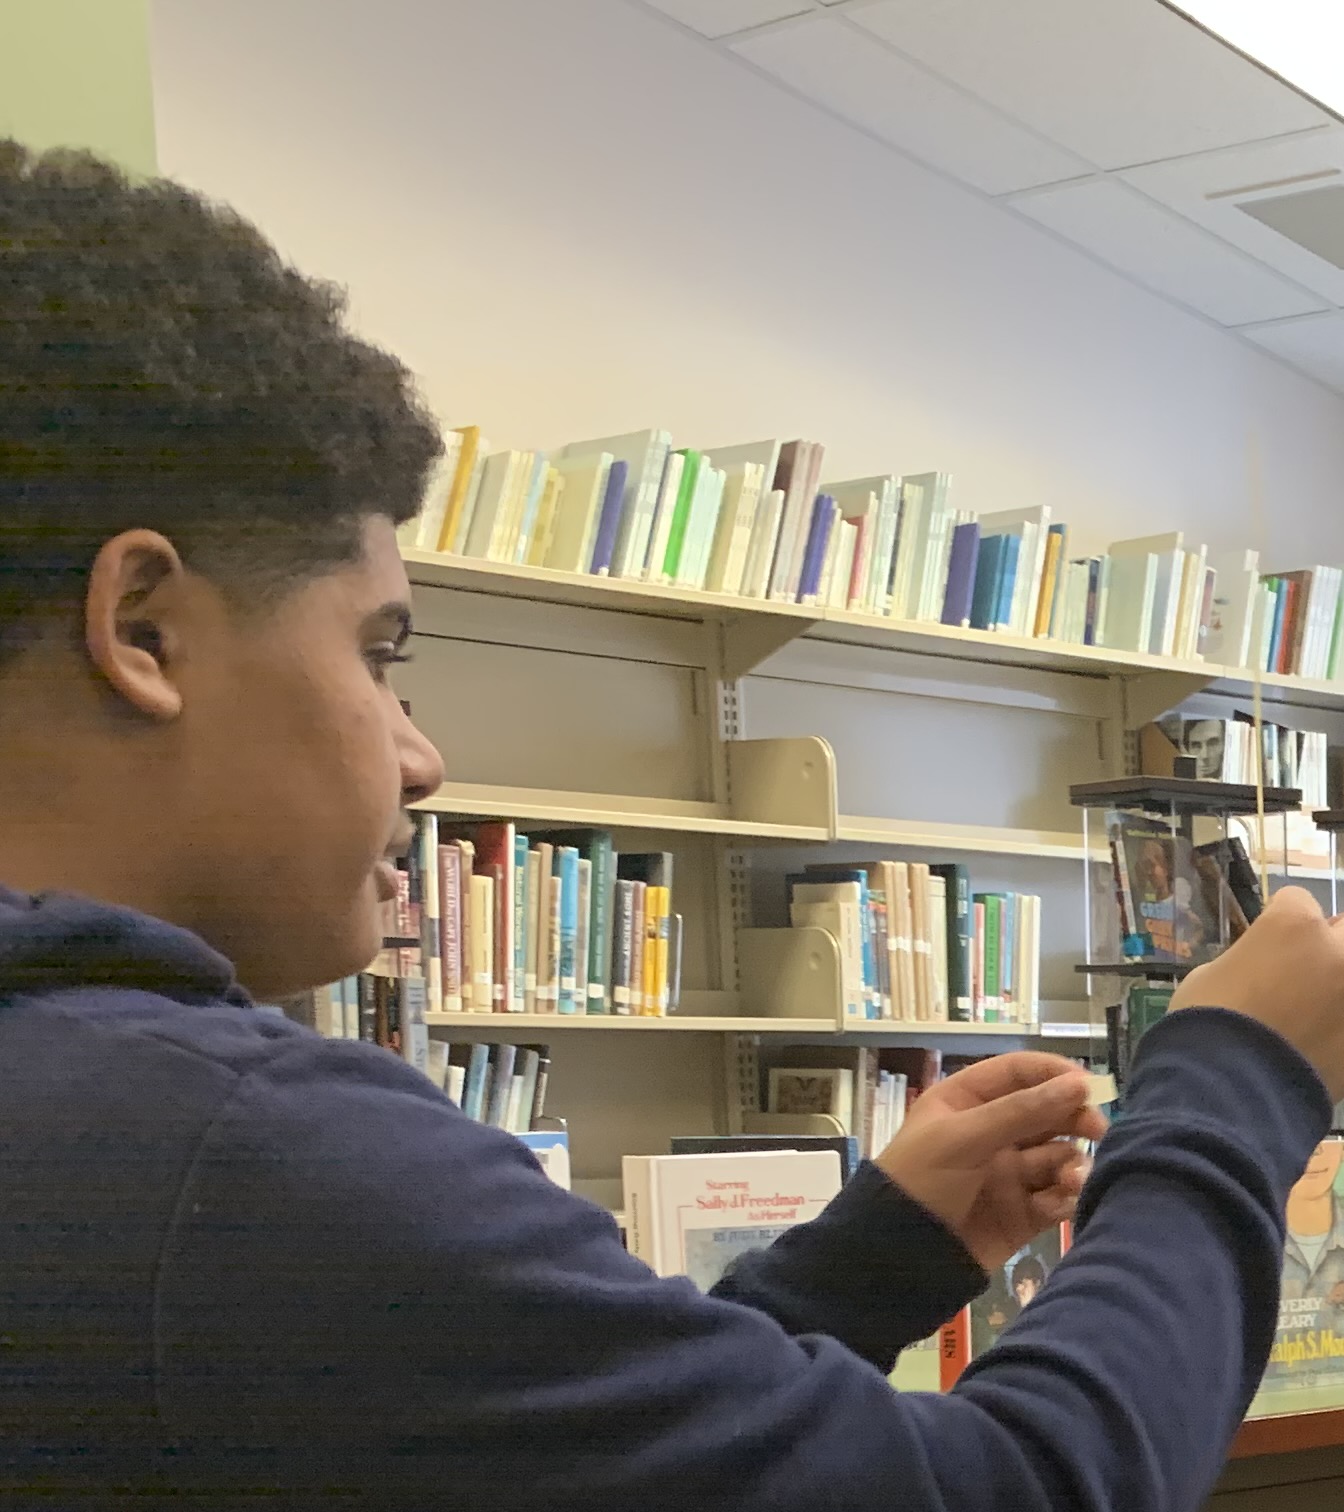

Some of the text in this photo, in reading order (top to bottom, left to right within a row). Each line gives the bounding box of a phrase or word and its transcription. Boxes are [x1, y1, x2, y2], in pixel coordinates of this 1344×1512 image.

[706, 1179, 749, 1192] Starring
[696, 1195, 726, 1213] Sally
[741, 1193, 806, 1208] Freedman
[1281, 1297, 1322, 1313] VERLY
[1277, 1314, 1317, 1330] EARY
[1270, 1333, 1306, 1368] alph
